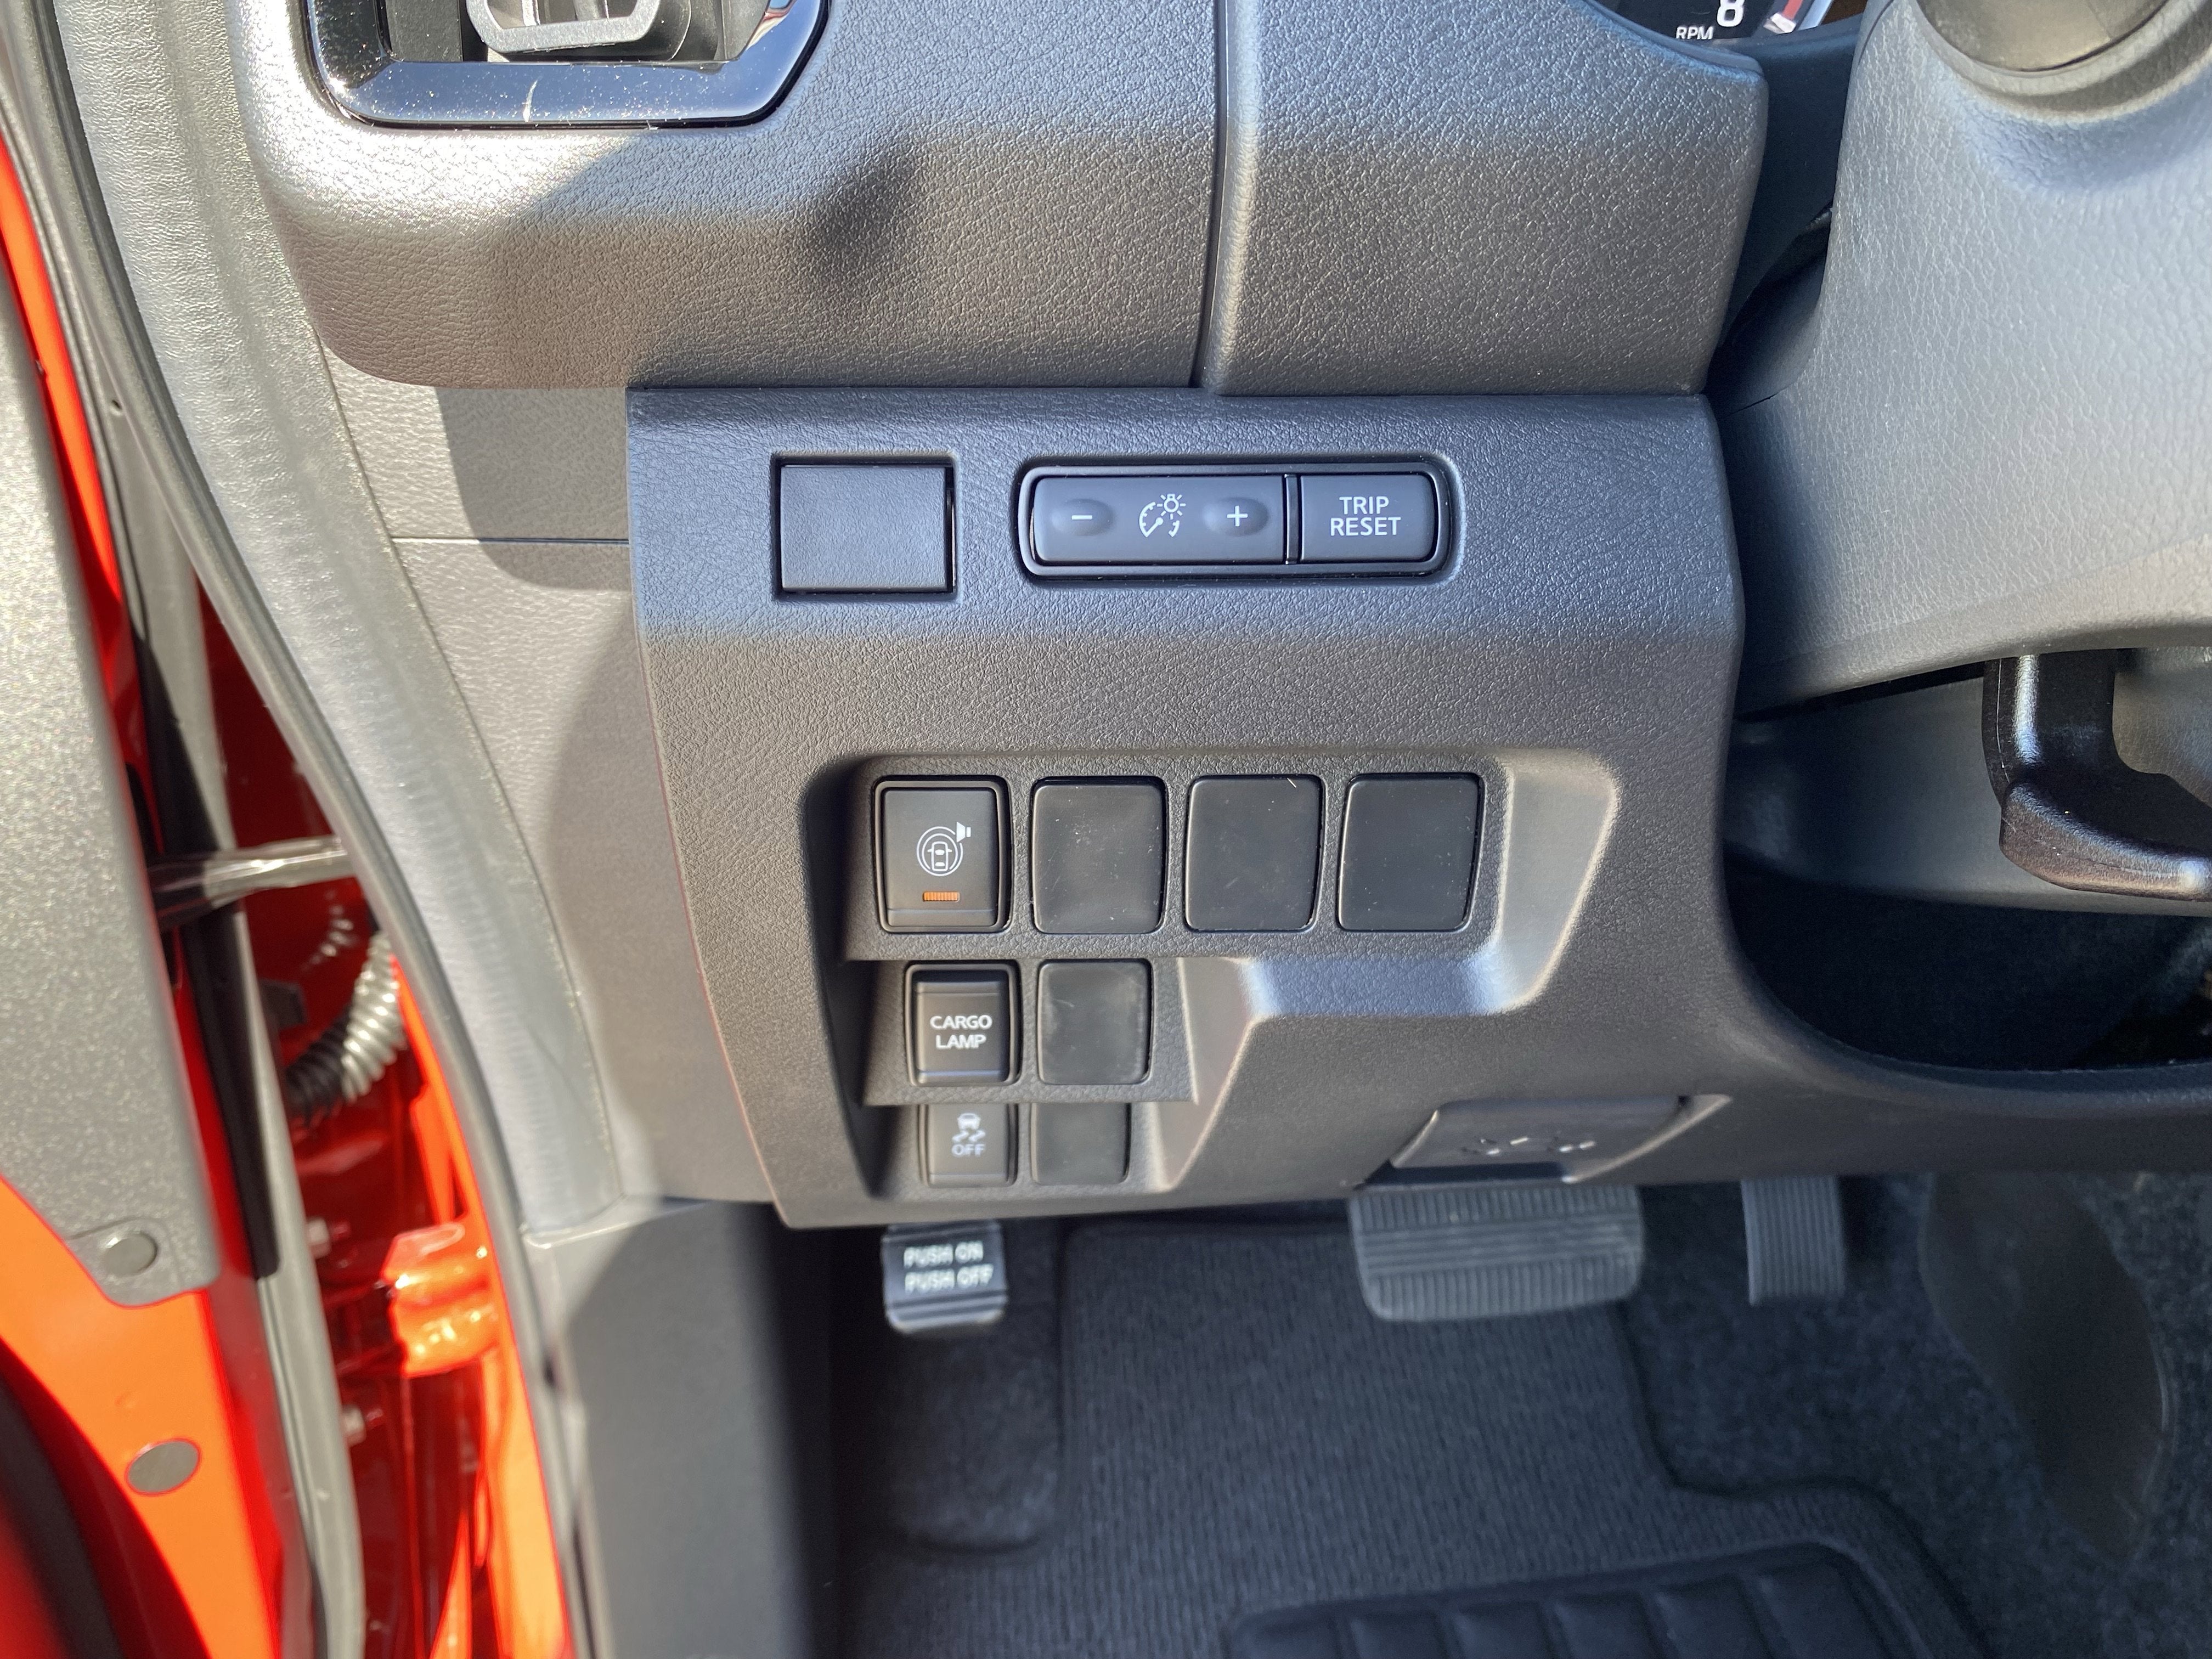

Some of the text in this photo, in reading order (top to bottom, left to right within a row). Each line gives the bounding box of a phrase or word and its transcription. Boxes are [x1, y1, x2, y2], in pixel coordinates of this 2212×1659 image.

[1716, 0, 1743, 27] 8
[1675, 26, 1713, 40] RPM
[1339, 495, 1390, 515] TRIP
[1329, 517, 1402, 536] RESET
[930, 1014, 992, 1029] CARGO
[935, 1035, 986, 1049] LAMP
[951, 1144, 985, 1157] OFF
[903, 1240, 984, 1267] PUSH ON
[904, 1263, 994, 1293] PUSH OFF
